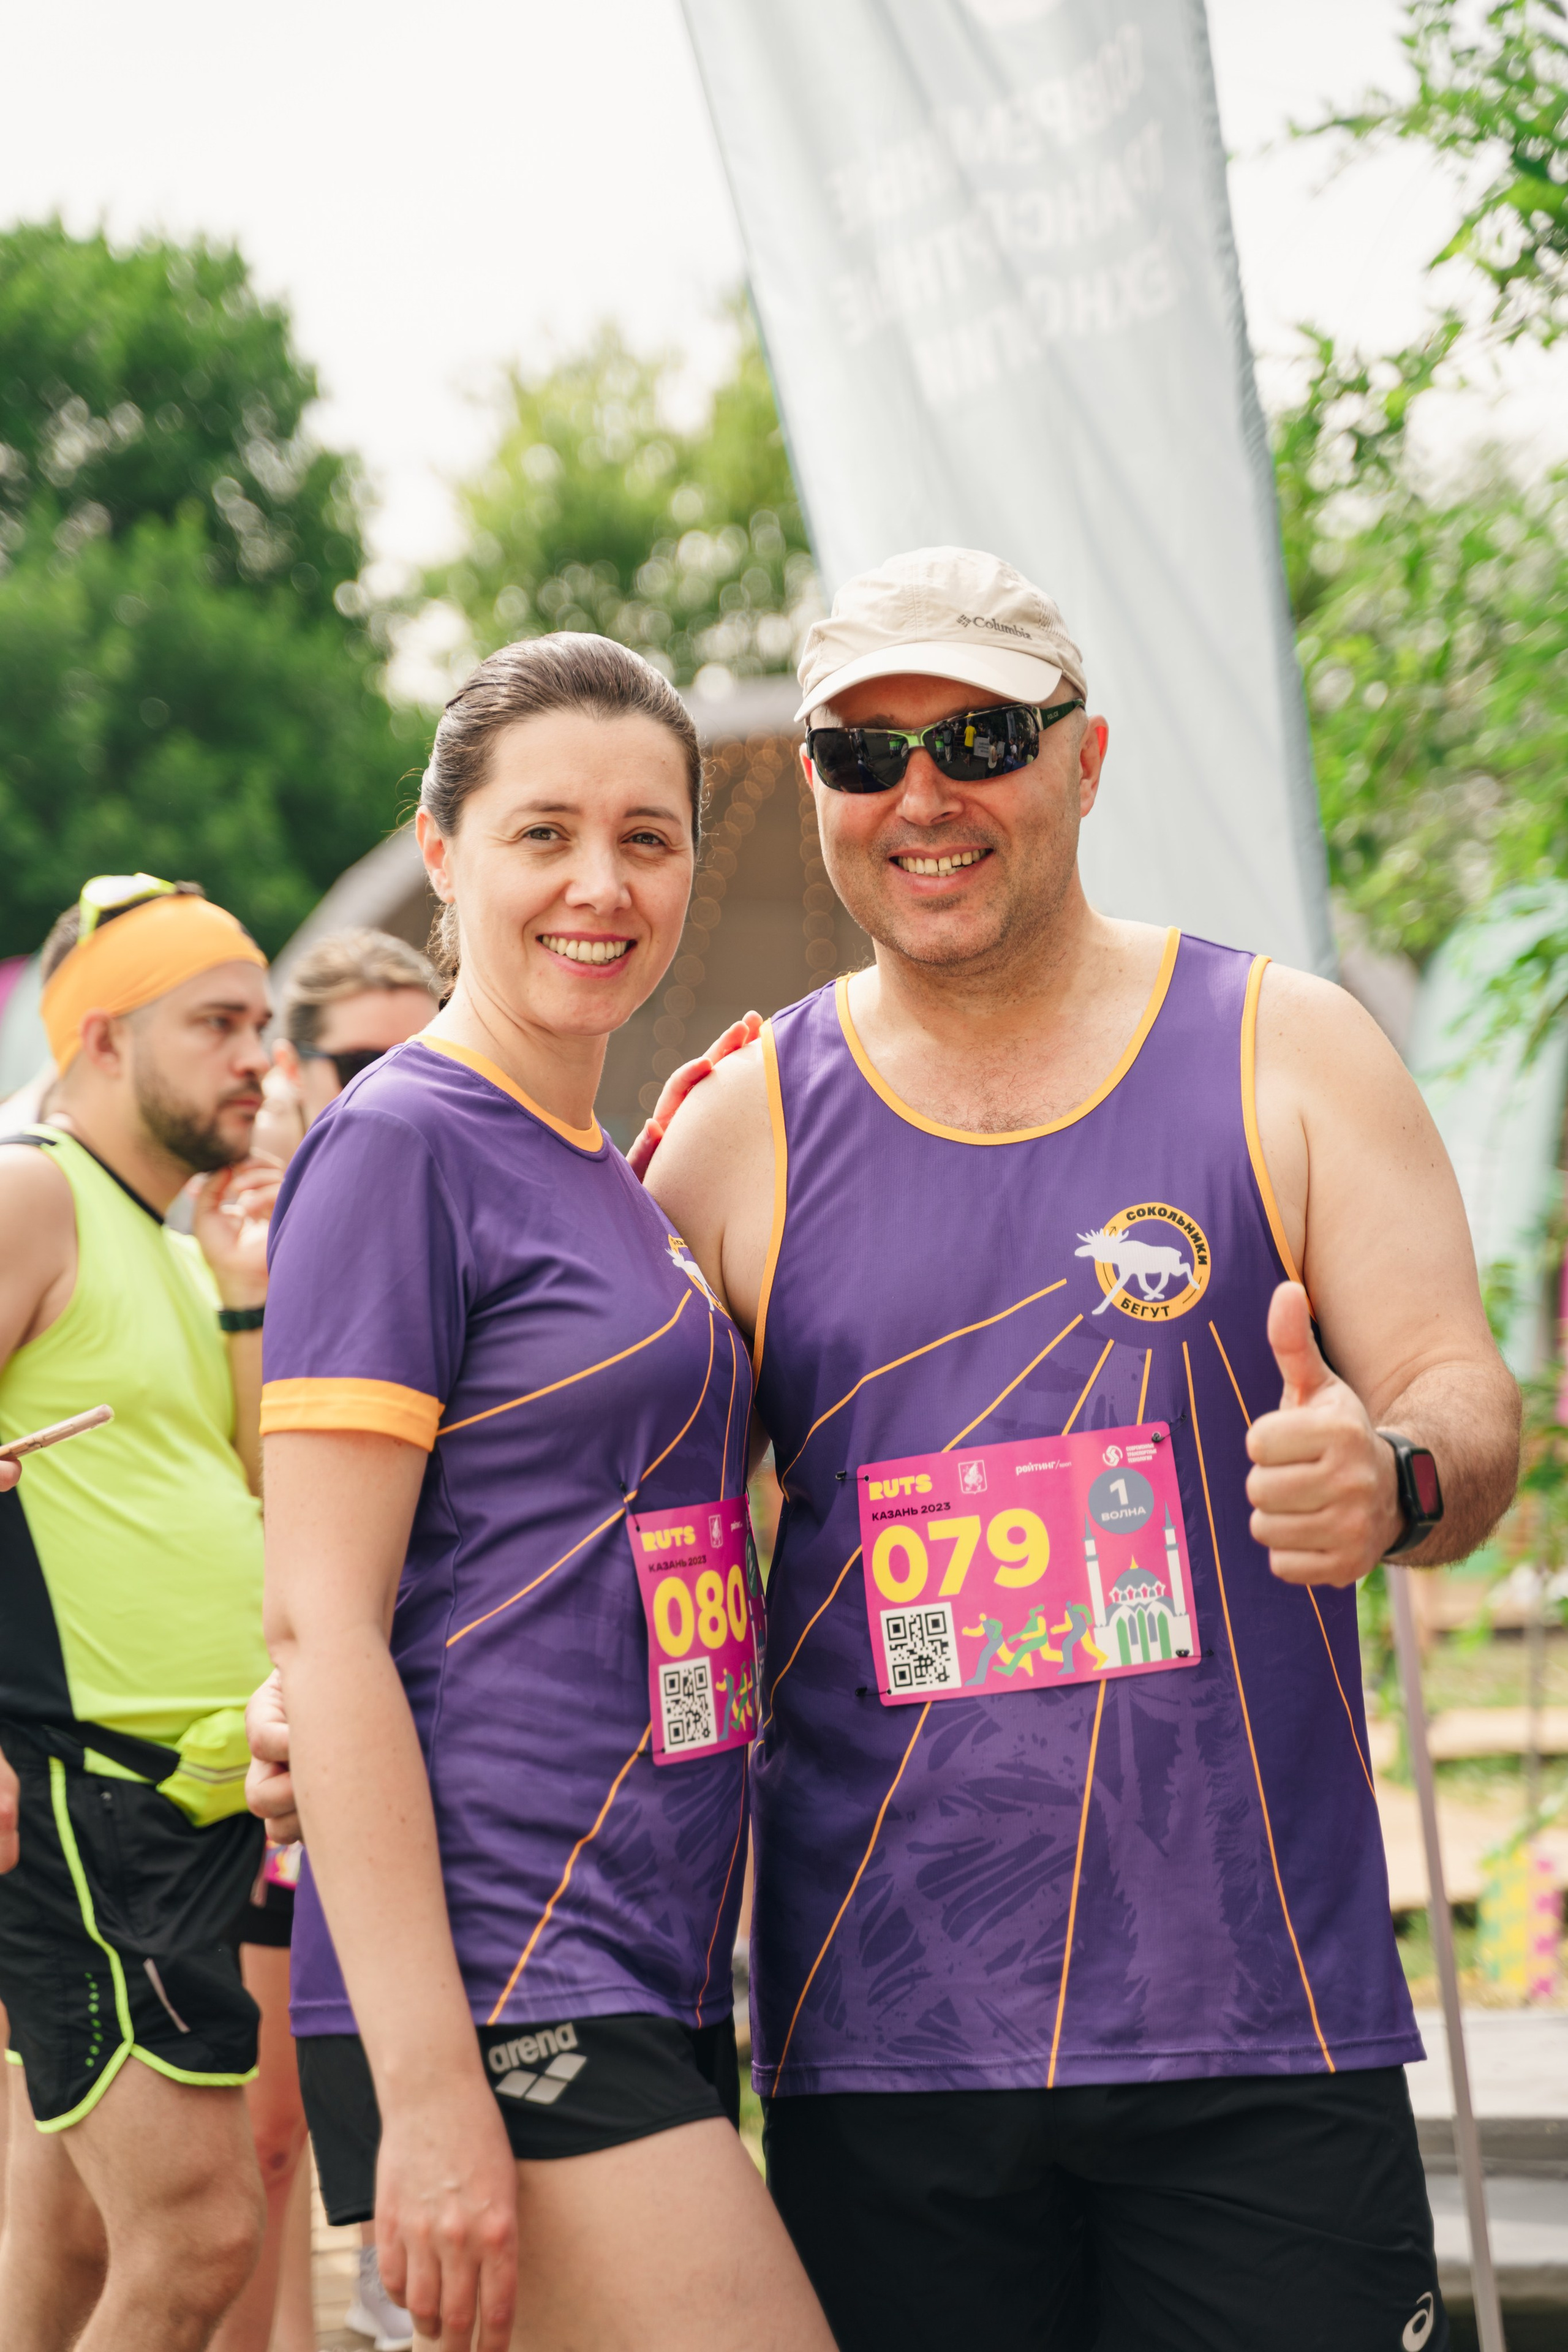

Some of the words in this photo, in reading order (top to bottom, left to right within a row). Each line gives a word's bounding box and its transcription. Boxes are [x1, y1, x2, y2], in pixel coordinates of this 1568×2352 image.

[973, 617, 1032, 640] Columbia
[1126, 1207, 1207, 1265] СОКОЛЬНИКИ
[1121, 1298, 1169, 1317] БЕГУТ
[869, 1474, 932, 1501] RUTS
[1110, 1479, 1128, 1505] 1
[872, 1507, 918, 1521] КАЗАНЬ
[921, 1502, 951, 1514] 2023
[1101, 1506, 1146, 1521] ВОЛНА
[641, 1526, 695, 1552] RUTS
[649, 1559, 687, 1572] КАЗАНЬ
[688, 1555, 707, 1566] 2023
[872, 1509, 1050, 1603] 079
[654, 1564, 747, 1657] 080
[488, 2022, 578, 2074] arena
